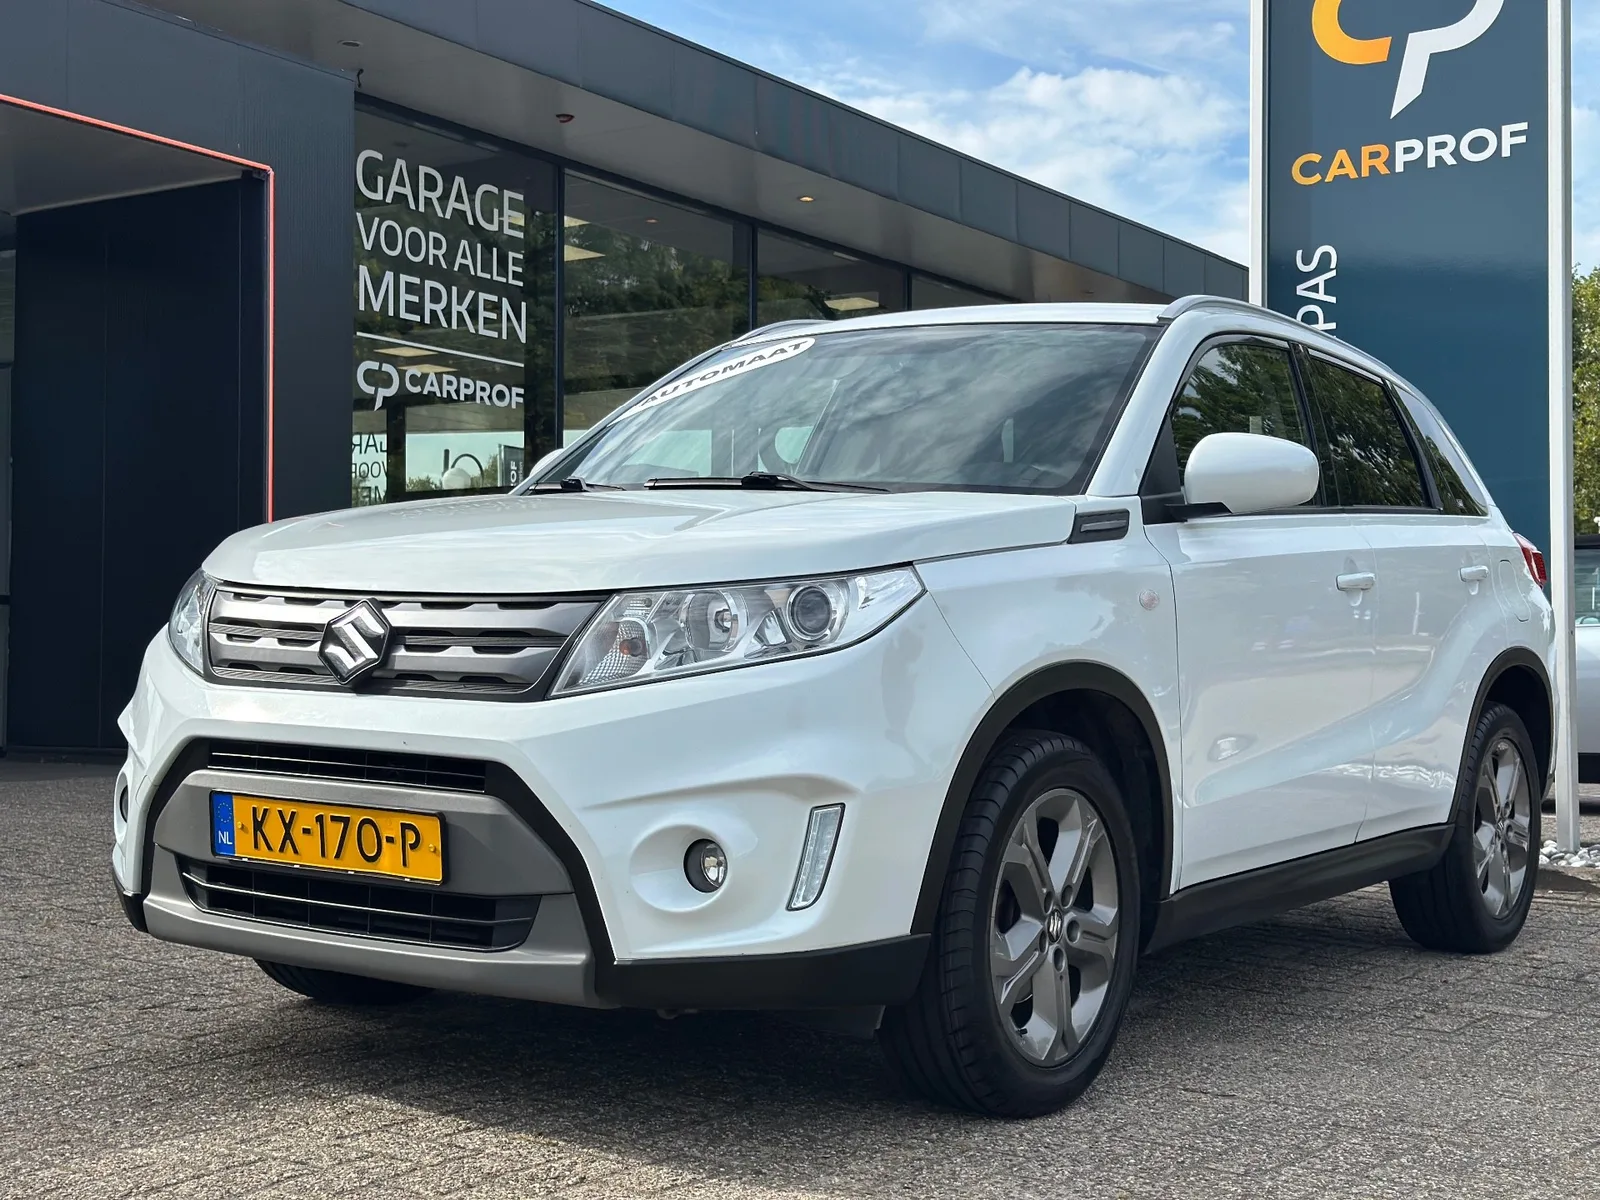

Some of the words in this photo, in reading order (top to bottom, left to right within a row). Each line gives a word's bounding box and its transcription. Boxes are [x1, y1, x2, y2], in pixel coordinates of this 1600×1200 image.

[1291, 121, 1529, 186] CARPROF
[356, 149, 525, 239] GARAGE
[356, 212, 448, 270] VOOR
[453, 239, 525, 287] ALLE
[358, 264, 527, 344] MERKEN
[404, 368, 525, 409] CARPROF
[639, 341, 808, 406] AUTOMAAT
[218, 831, 233, 846] NL
[251, 805, 421, 867] KX-170-P
